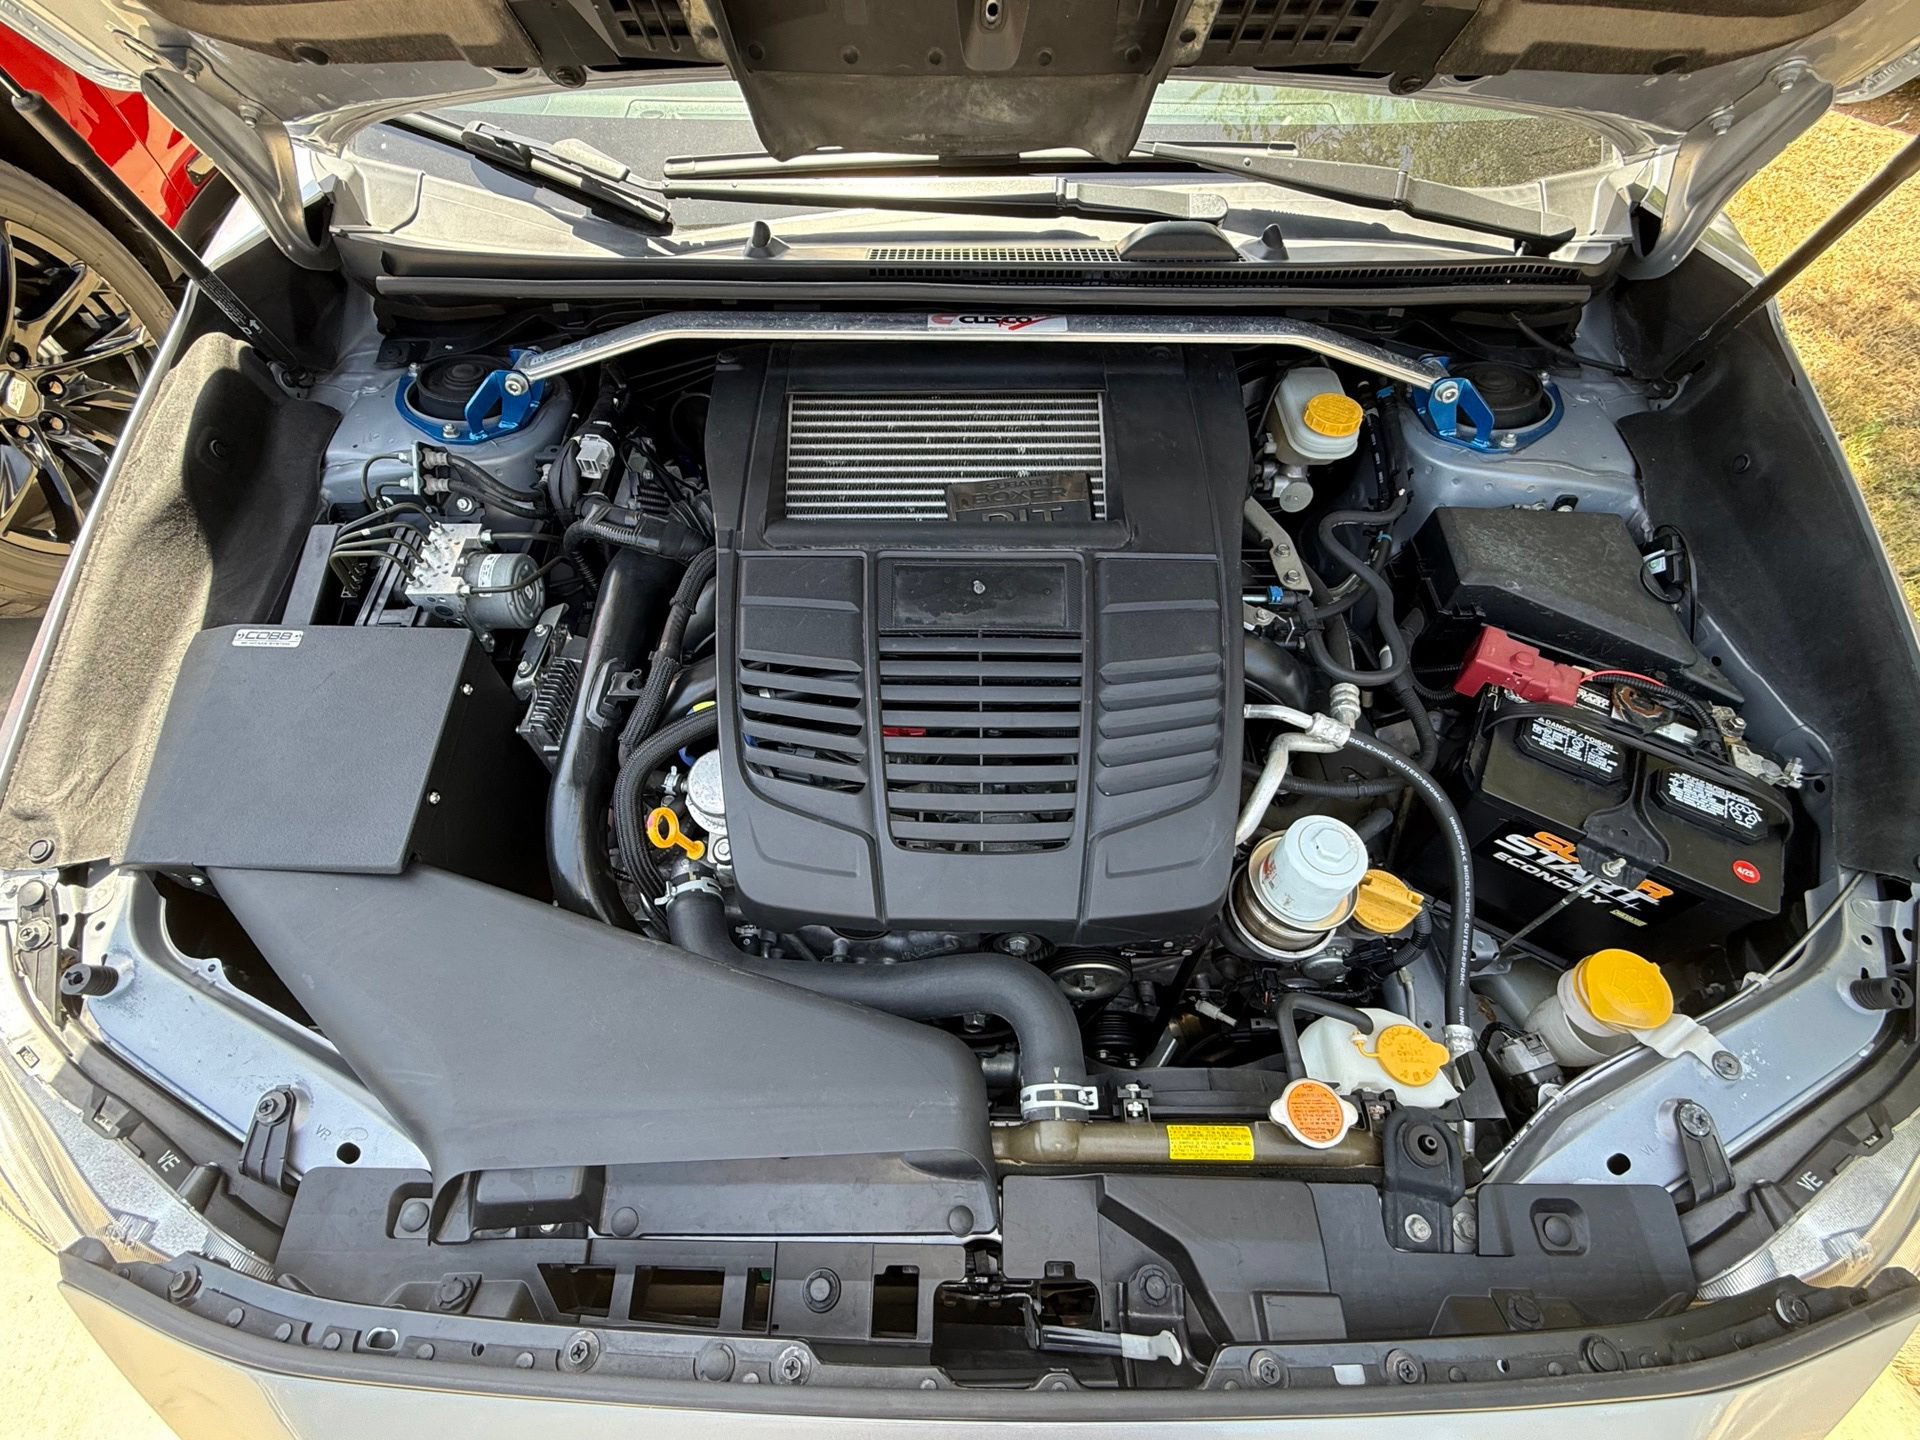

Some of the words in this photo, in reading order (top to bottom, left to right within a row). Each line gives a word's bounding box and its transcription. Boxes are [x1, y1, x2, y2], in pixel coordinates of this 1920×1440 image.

[958, 315, 1032, 324] CUSCO
[974, 487, 1068, 504] BOXER
[244, 631, 293, 640] COBB
[1545, 719, 1577, 735] DANGER
[1584, 734, 1614, 750] POISON
[1494, 833, 1661, 906] START
[1458, 1006, 1466, 1026] INN
[156, 1149, 182, 1172] VE
[1795, 1170, 1824, 1192] VE
